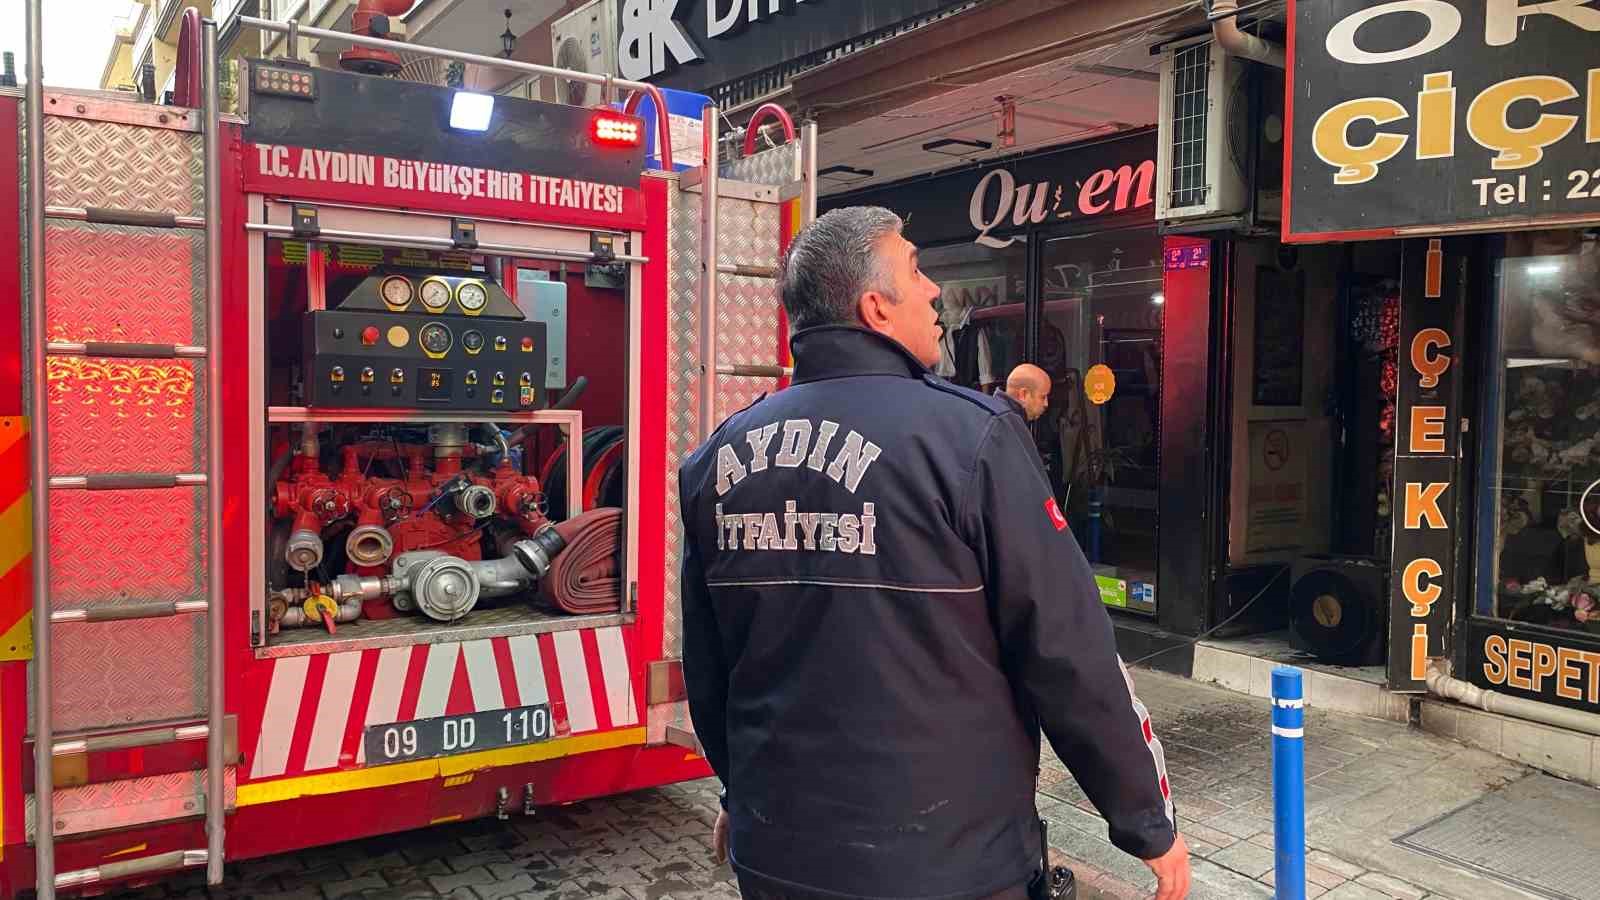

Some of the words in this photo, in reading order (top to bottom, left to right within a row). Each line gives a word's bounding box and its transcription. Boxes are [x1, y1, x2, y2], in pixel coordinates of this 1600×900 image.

[1311, 68, 1600, 185] ÇİÇ
[255, 143, 294, 178] T.C.
[299, 149, 375, 186] AYDIN
[1472, 174, 1526, 206] Tel
[968, 158, 1156, 249] Quen
[715, 419, 882, 497] AYDIN
[715, 500, 877, 556] İTFAİYESİ
[384, 726, 418, 759] 09
[443, 717, 476, 751] DD
[502, 708, 547, 743] 110
